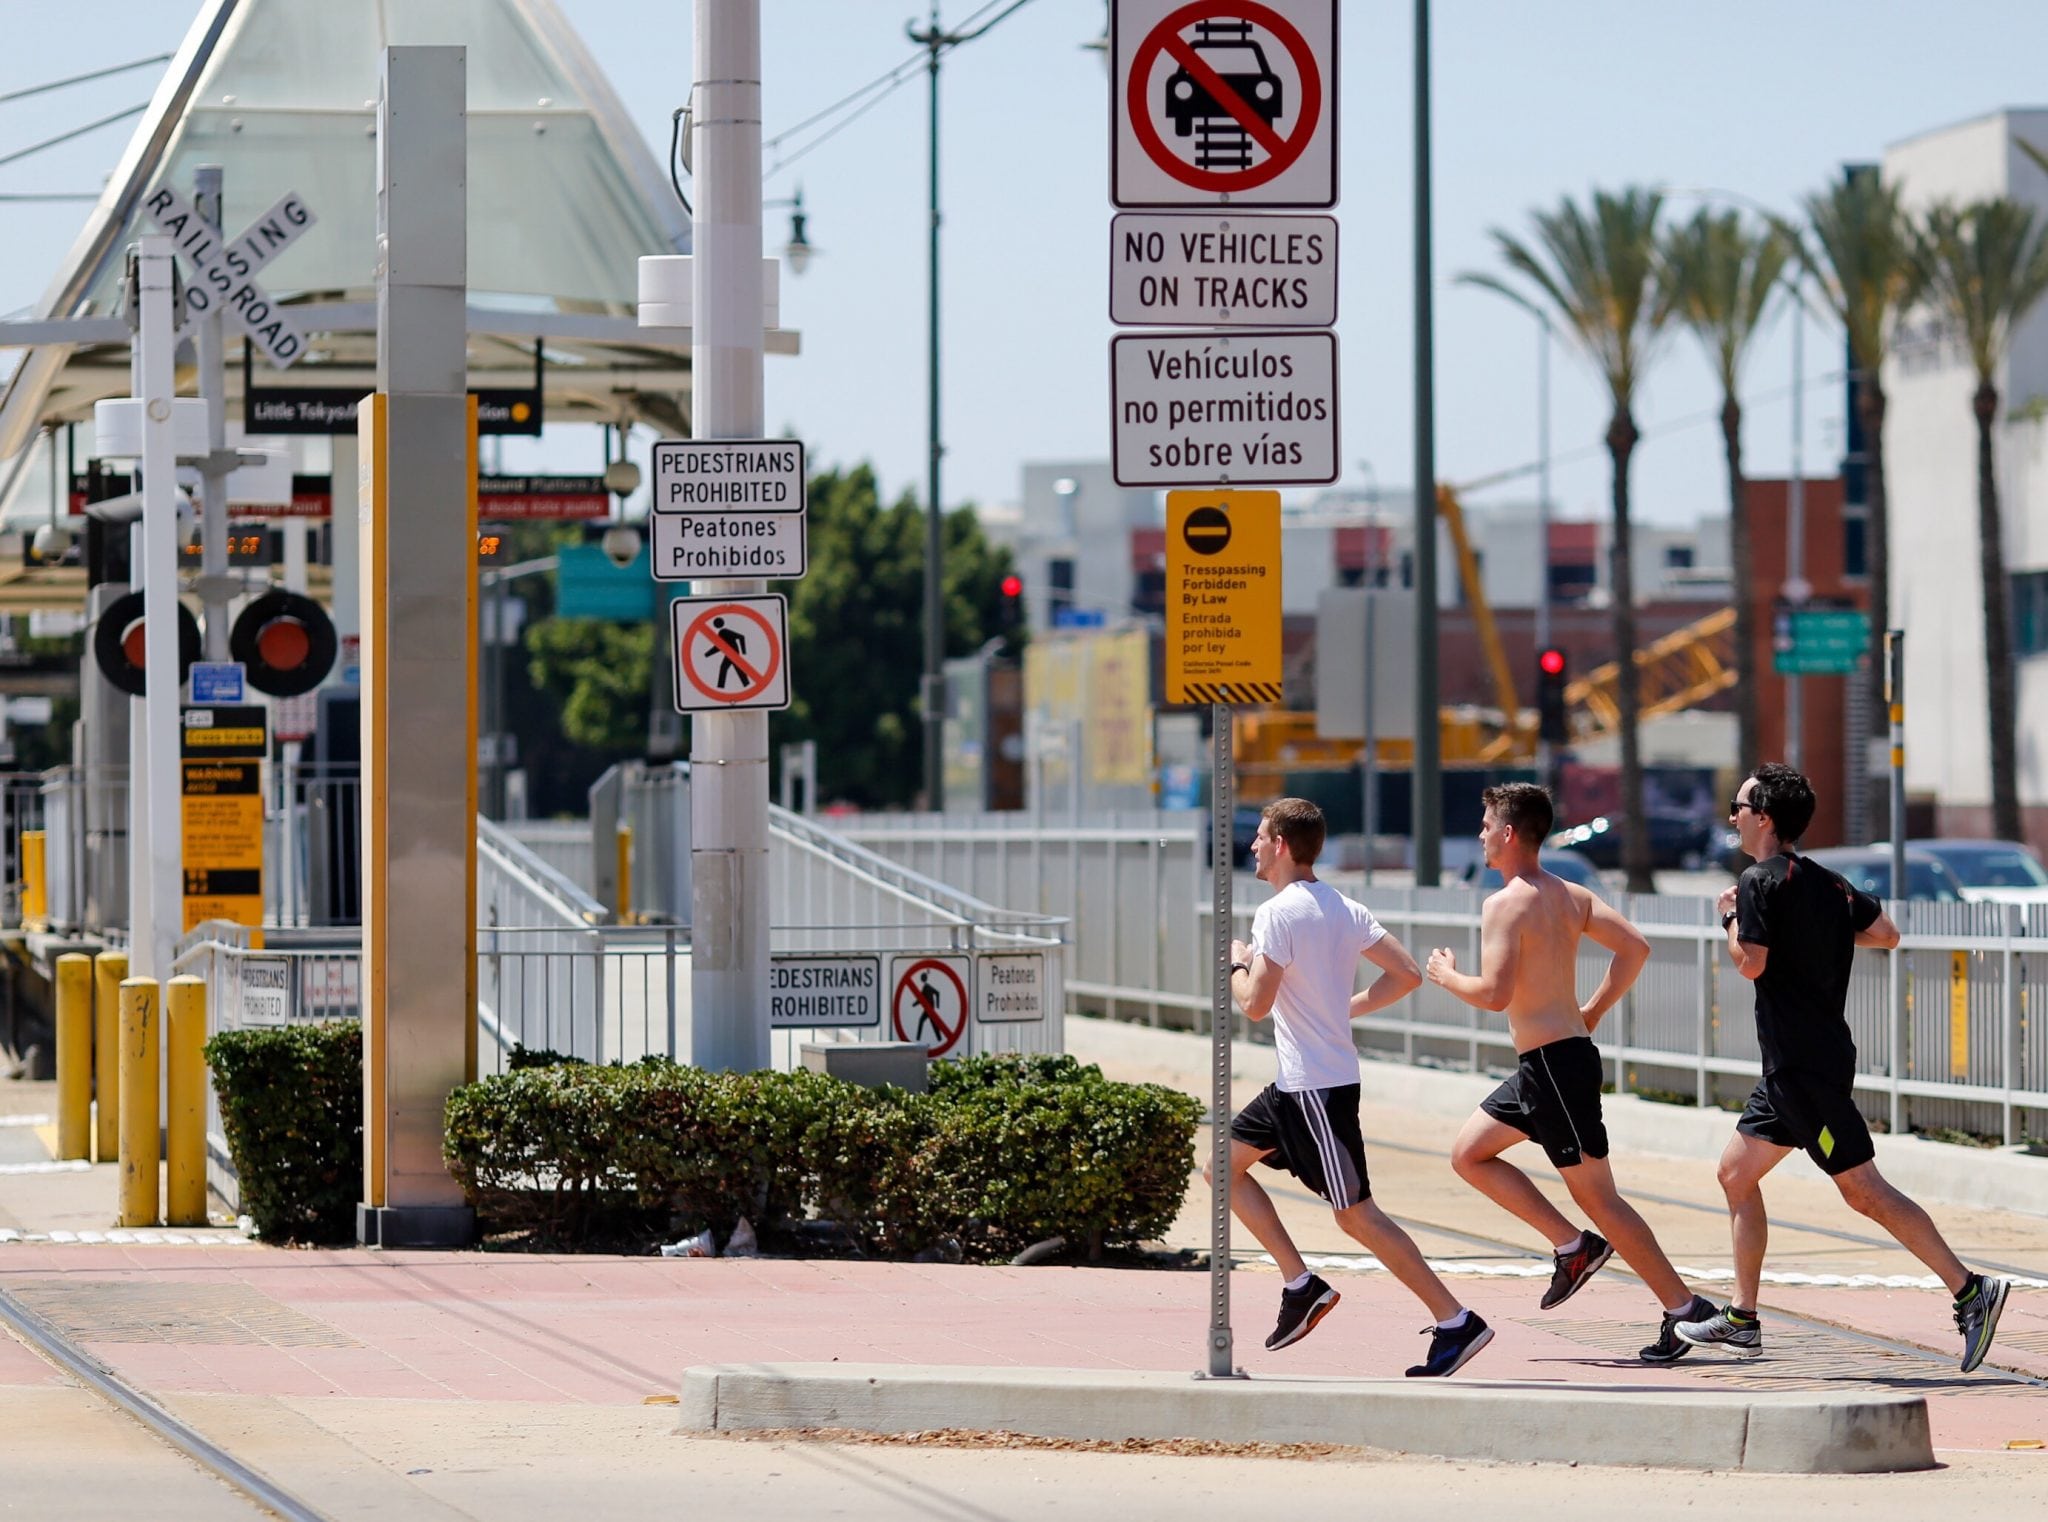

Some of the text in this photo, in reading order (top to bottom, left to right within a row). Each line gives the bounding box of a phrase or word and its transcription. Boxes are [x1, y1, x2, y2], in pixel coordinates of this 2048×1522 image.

[1125, 232, 1323, 265] NO VEHICLES
[148, 189, 299, 358] RAIL ROAD
[176, 201, 307, 331] OSSING
[1140, 276, 1308, 308] ON TRACKS
[1148, 346, 1293, 380] Vehículos
[254, 402, 295, 420] Little
[478, 402, 510, 420] tion
[1125, 391, 1327, 430] no permitidos
[1149, 432, 1303, 467] sobre vías
[662, 452, 795, 474] PEDESTRIANS
[671, 481, 787, 503] PROHIBITED
[681, 517, 776, 538] Peatones
[673, 546, 785, 567] Prohibidos
[1184, 564, 1266, 577] Tresspassing
[1183, 579, 1247, 590] Forbidden
[1183, 594, 1227, 606] By Law
[1183, 613, 1231, 624] Entrada
[1183, 628, 1241, 640] prohibida
[1183, 643, 1225, 655] por ley
[186, 768, 243, 780] WARNING
[770, 967, 873, 988] EDESTRIANS
[992, 965, 1035, 984] Peatones
[771, 996, 868, 1016] ROHIBITED
